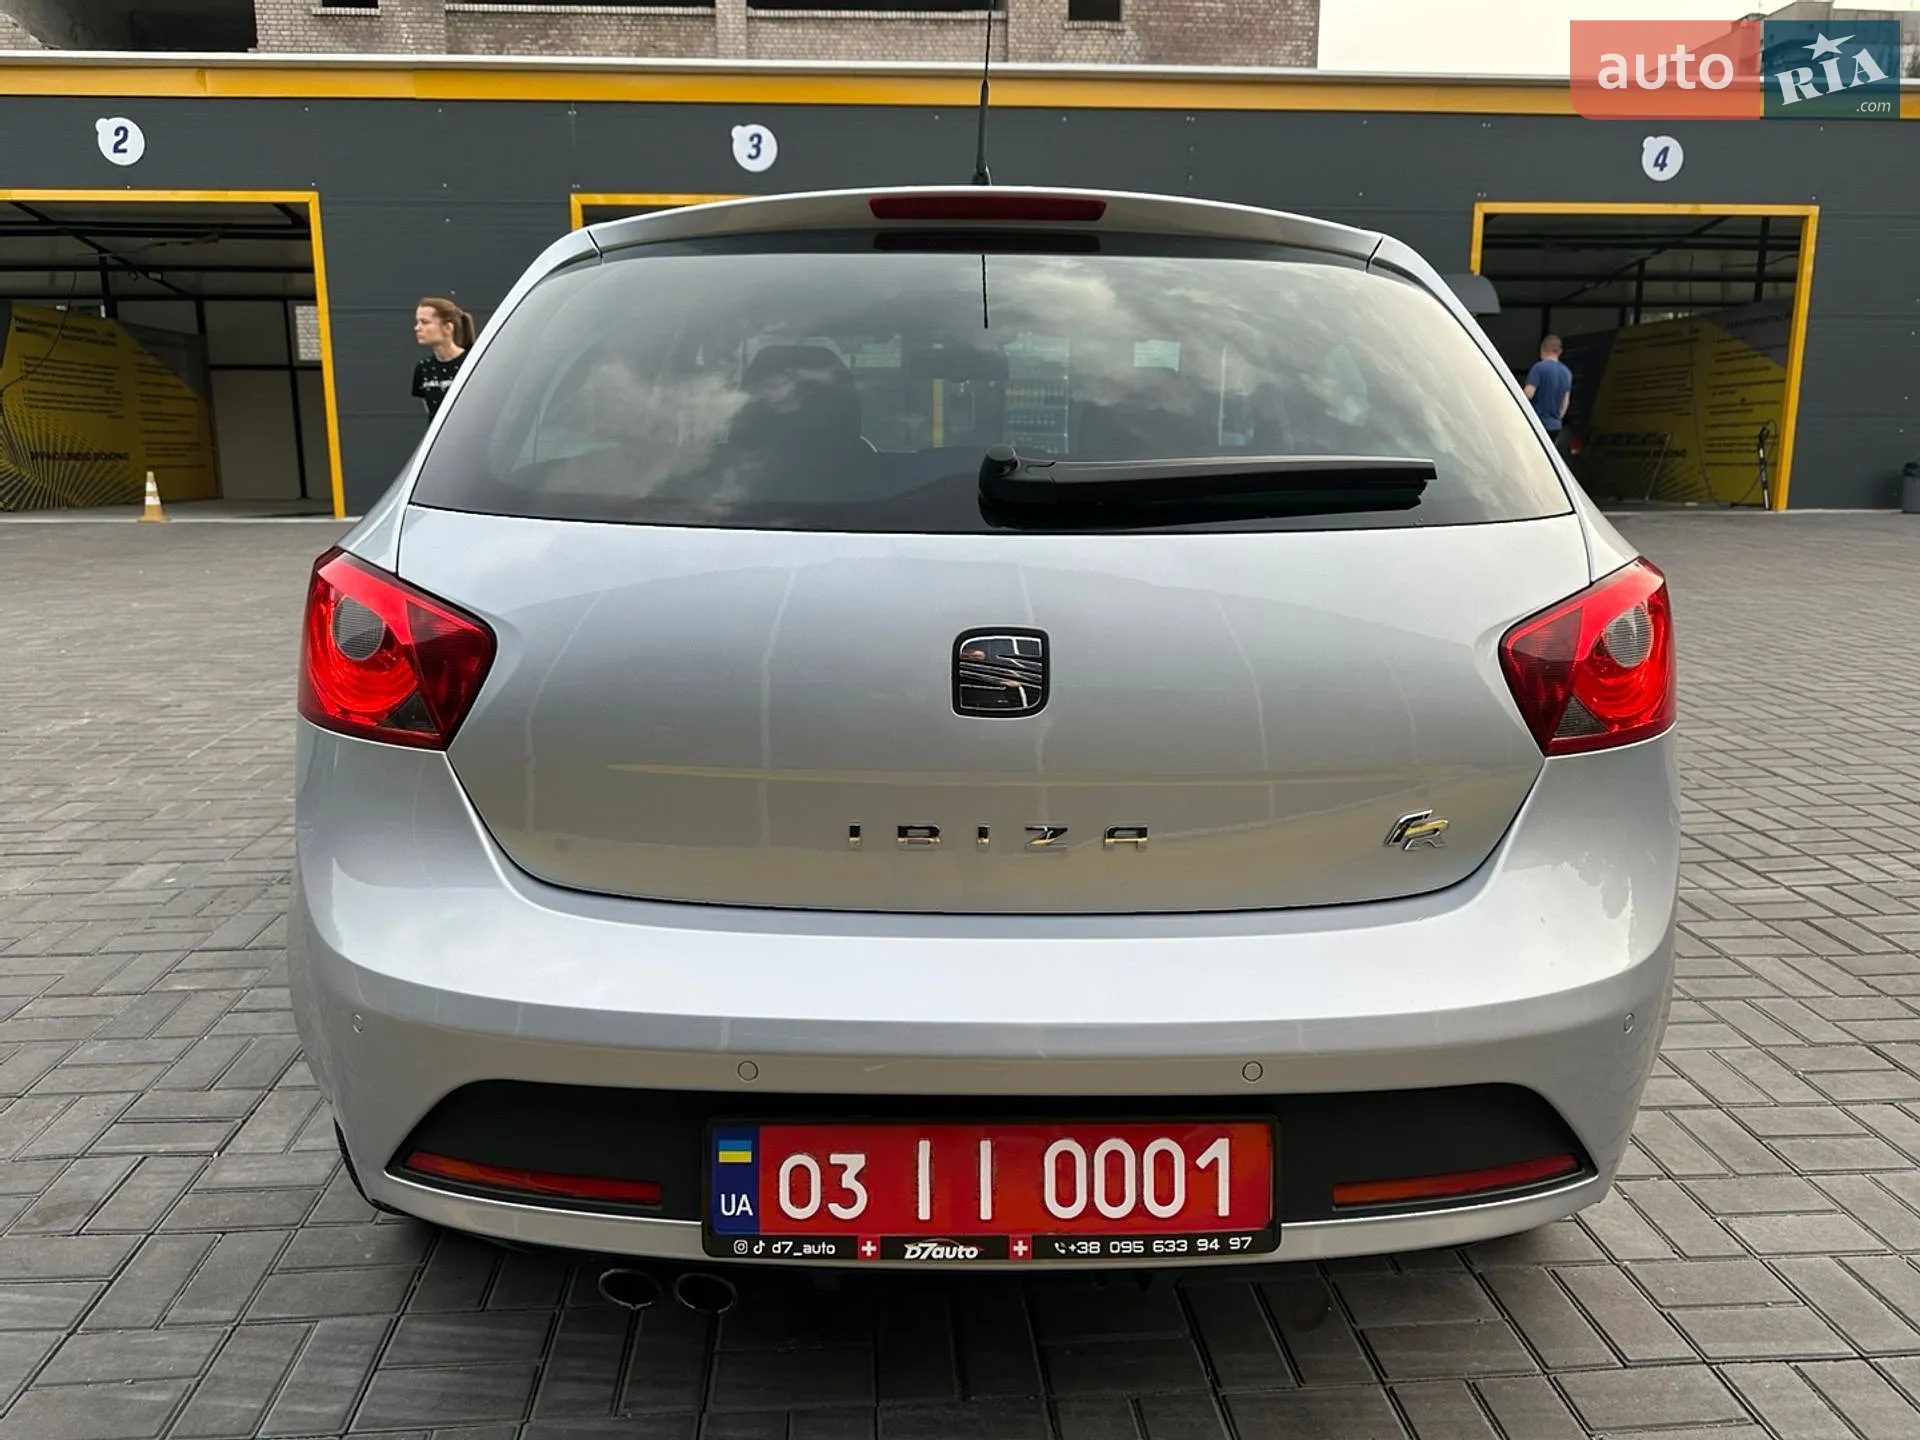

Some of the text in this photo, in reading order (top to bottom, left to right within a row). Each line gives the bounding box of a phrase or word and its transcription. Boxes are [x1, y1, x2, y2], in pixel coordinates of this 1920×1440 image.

[113, 125, 129, 154] 2
[747, 132, 762, 160] 3
[1653, 145, 1670, 172] 4
[848, 823, 1149, 851] IBIZA
[778, 1152, 869, 1221] 03
[1043, 1137, 1230, 1220] 0001
[720, 1193, 753, 1217] UA
[771, 1241, 836, 1256] d7_auto
[1069, 1236, 1253, 1254] +38 095 633 94 97
